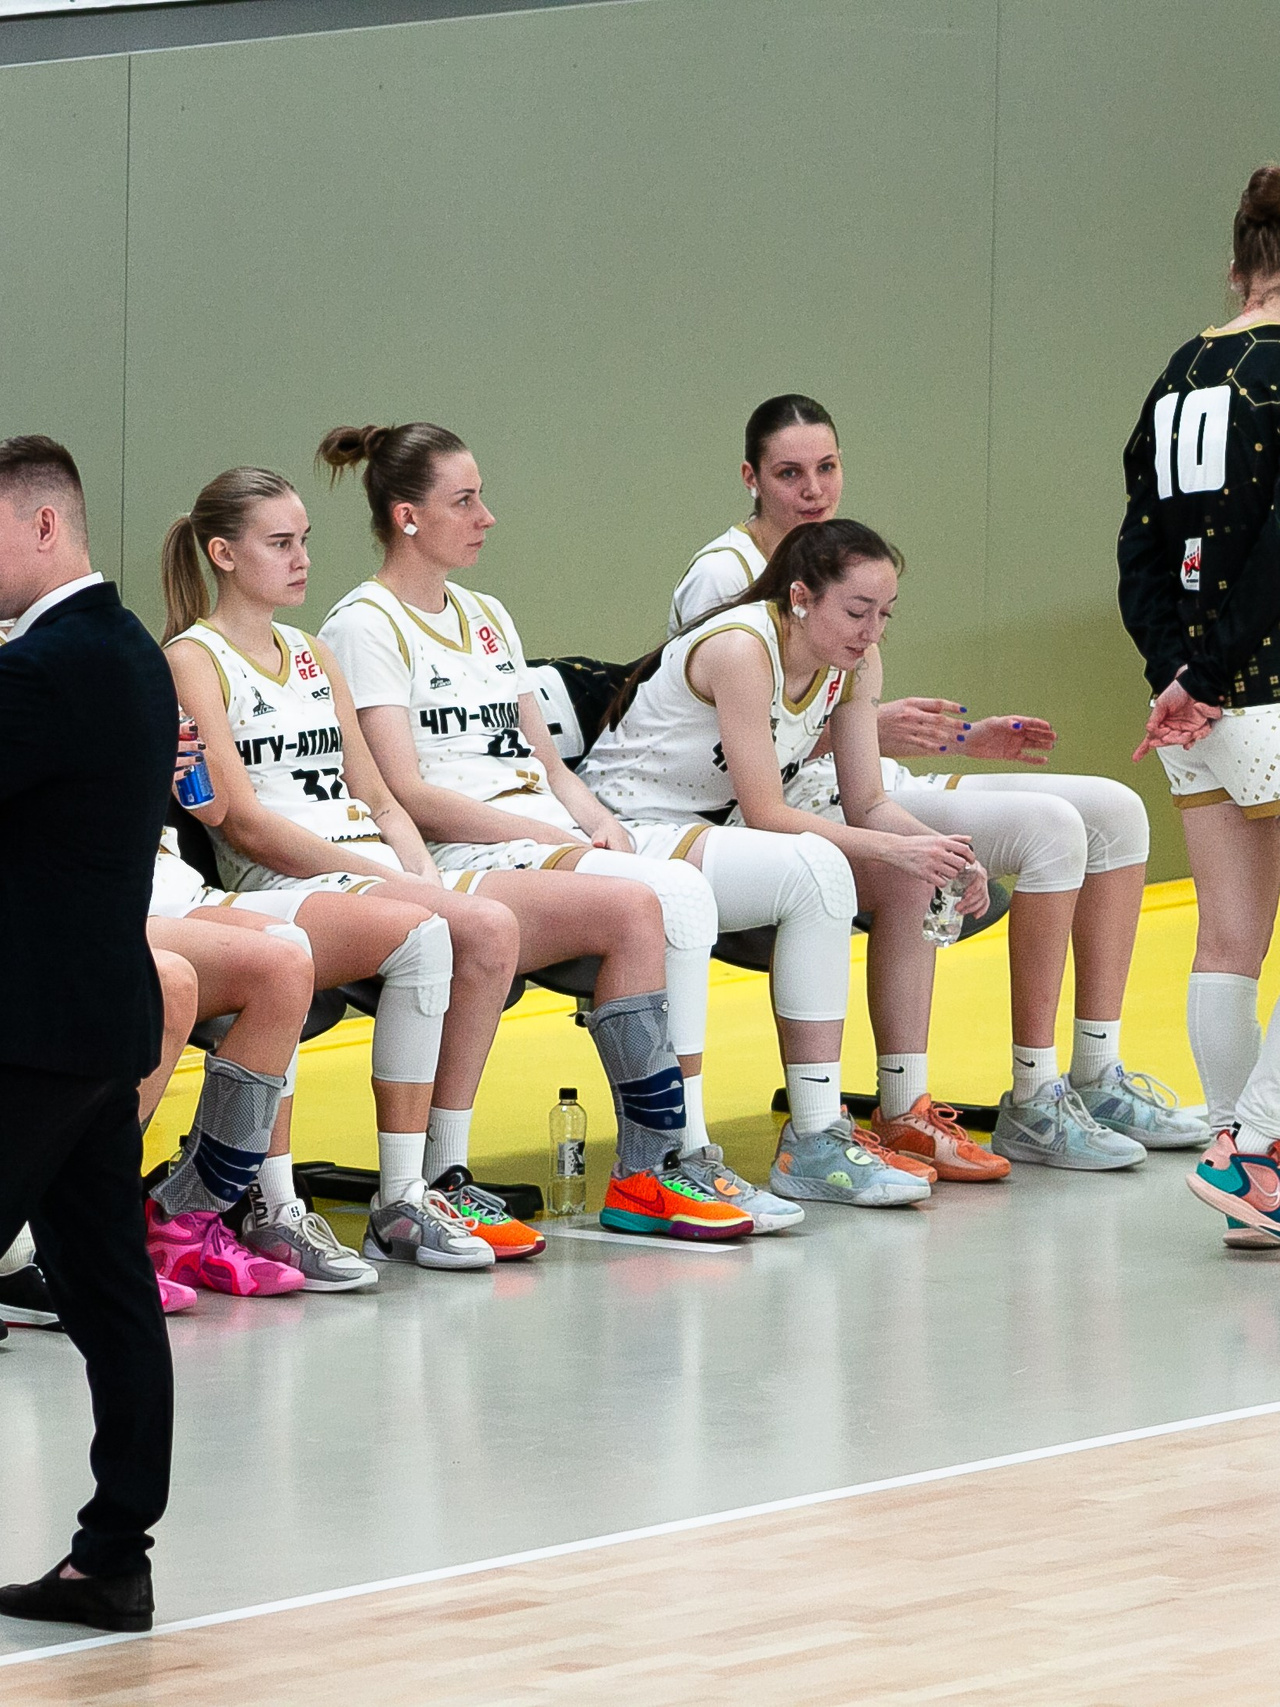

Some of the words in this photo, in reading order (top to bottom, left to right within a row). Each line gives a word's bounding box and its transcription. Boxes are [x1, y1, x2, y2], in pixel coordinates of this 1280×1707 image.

[1154, 385, 1231, 499] 10
[295, 651, 312, 668] FO
[234, 726, 343, 766] ЧГУ-АТЛА
